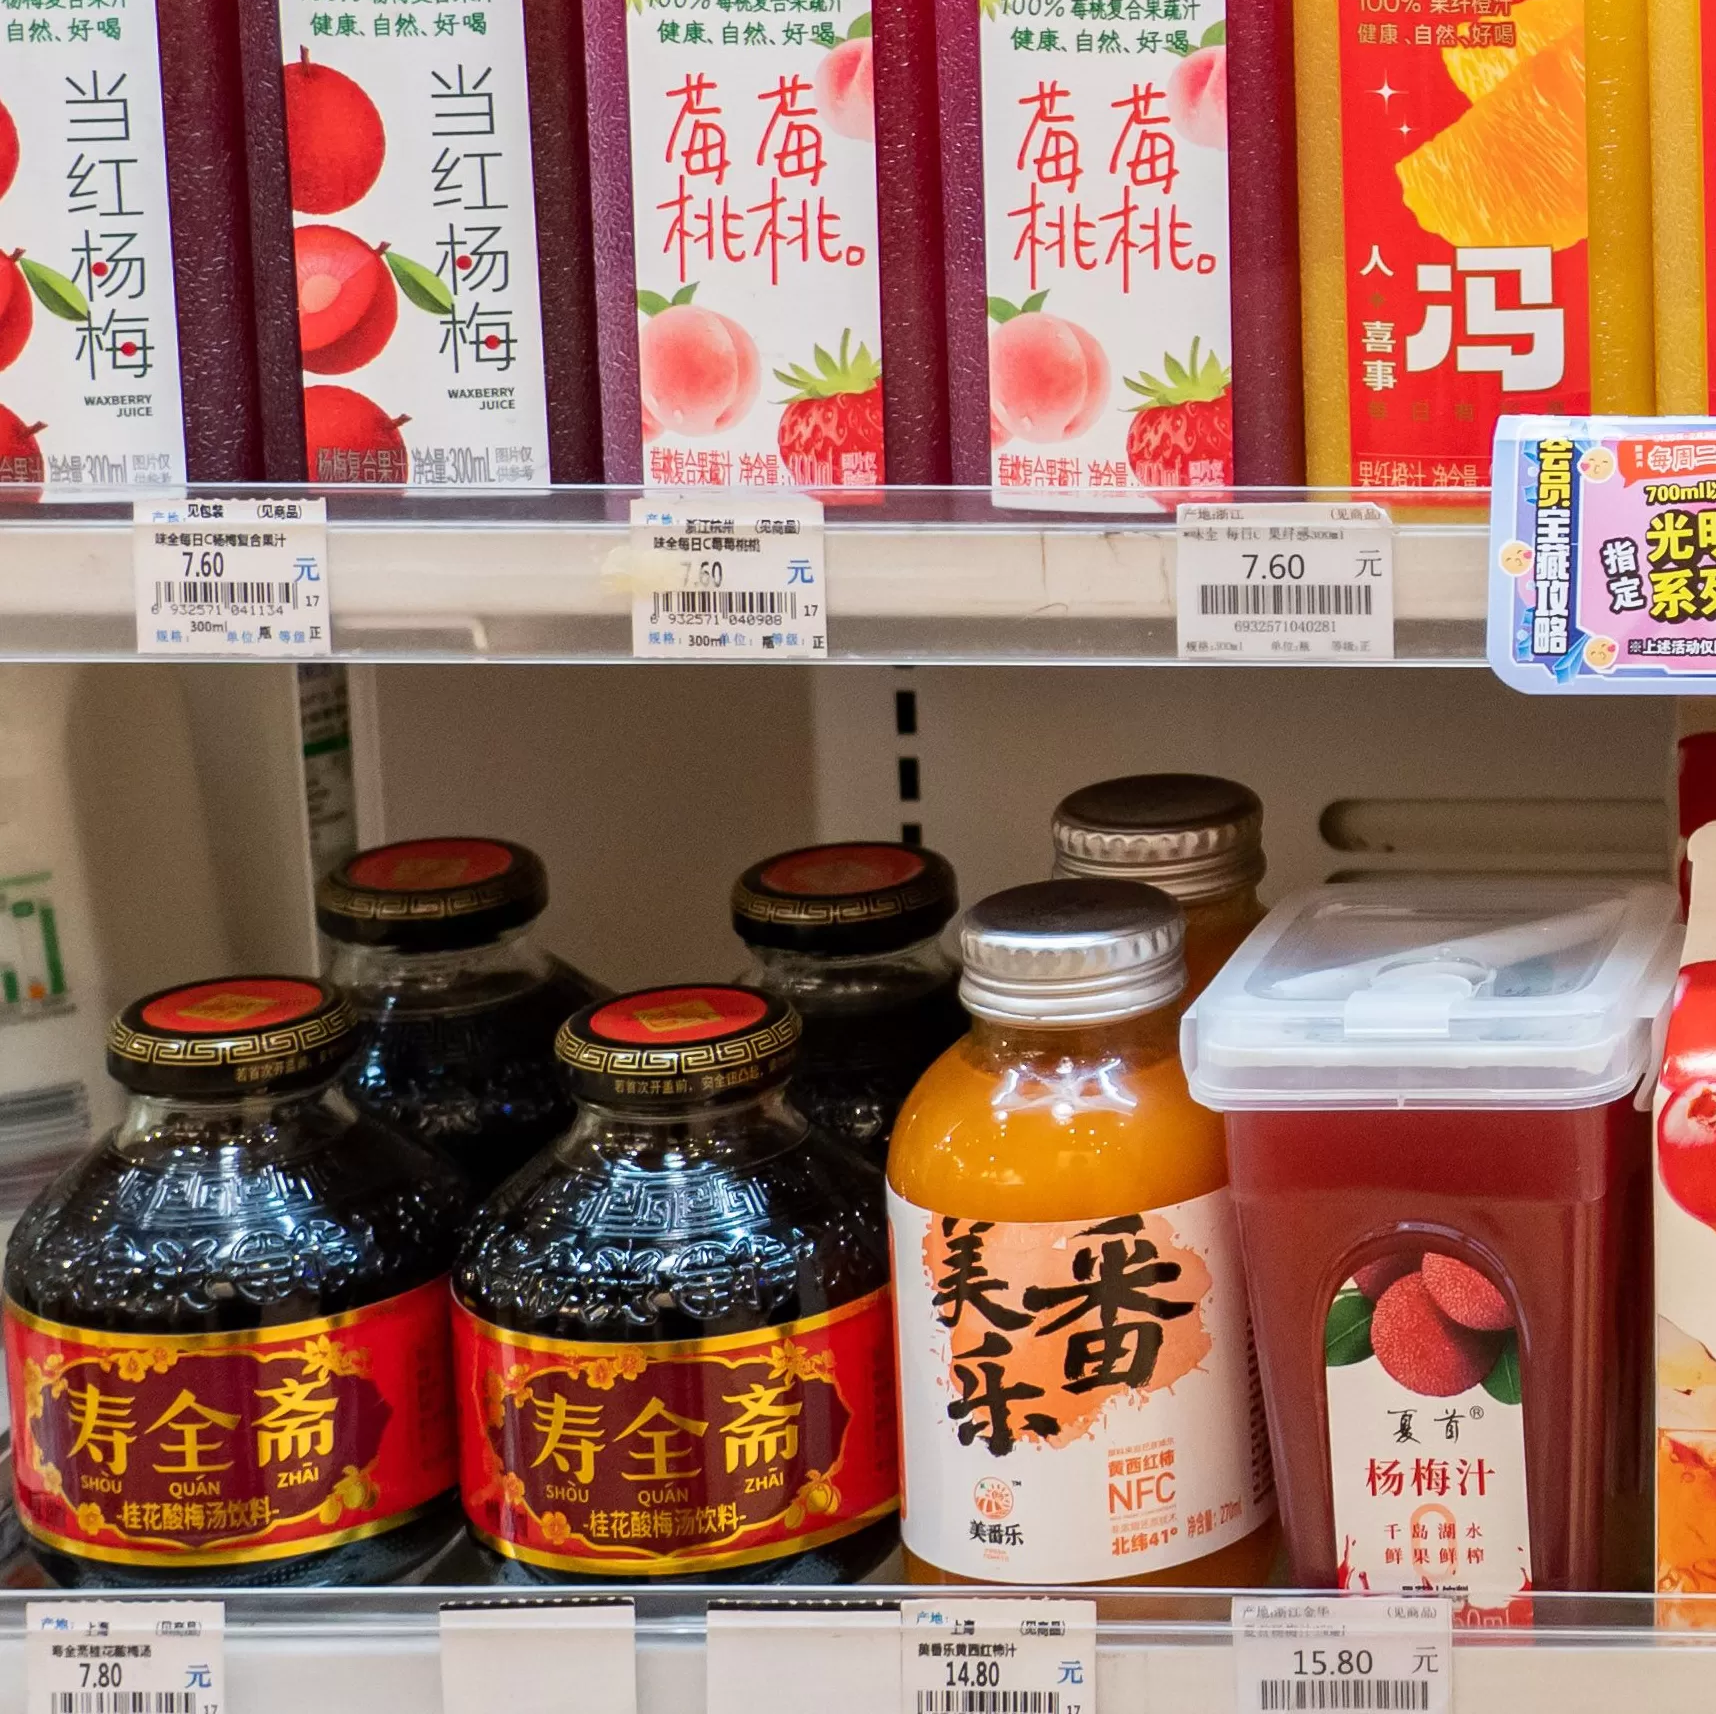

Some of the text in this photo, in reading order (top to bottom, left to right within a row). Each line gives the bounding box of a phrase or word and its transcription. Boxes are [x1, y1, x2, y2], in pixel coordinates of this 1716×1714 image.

[66, 70, 155, 381] 当红杨梅
[431, 64, 518, 374] 当红杨梅
[1407, 245, 1565, 392] 冯
[84, 394, 152, 407] WAXBERRY
[447, 387, 515, 399] WAXBERRY
[479, 399, 516, 411] JUICE
[116, 406, 153, 418] JUICE
[182, 551, 321, 583] 7.60 元
[1242, 549, 1383, 580] 7.60 元
[68, 1376, 339, 1478] 寿全斋
[532, 1383, 802, 1486] 寿全斋
[1364, 1457, 1496, 1498] 杨梅汁
[78, 1662, 212, 1690] 7.80 元
[1292, 1646, 1374, 1679] 15.80
